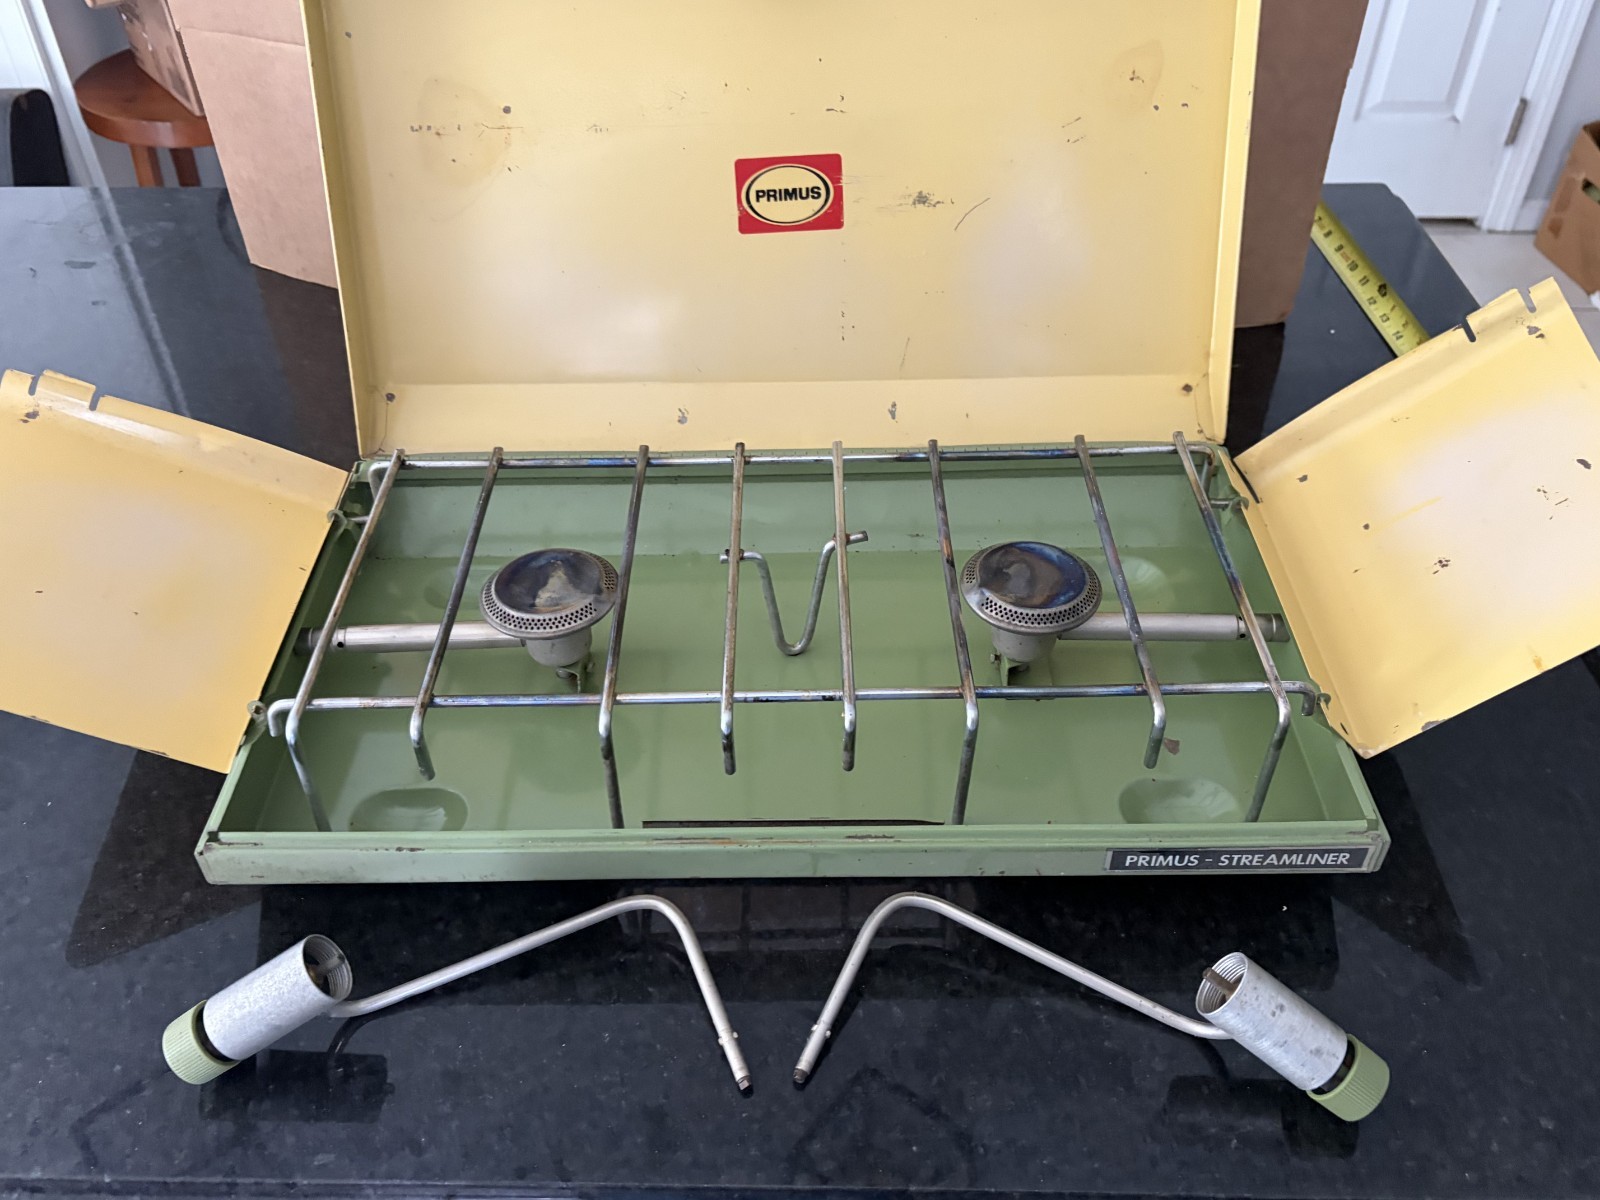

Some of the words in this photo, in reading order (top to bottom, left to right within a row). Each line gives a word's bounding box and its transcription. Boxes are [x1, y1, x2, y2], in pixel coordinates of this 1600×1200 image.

[755, 186, 822, 203] PRIMUS
[1347, 260, 1359, 272] 10
[1358, 275, 1370, 286] 11
[1366, 296, 1377, 306] 12
[1379, 313, 1390, 323] 13
[1392, 330, 1404, 341] 14
[1124, 854, 1200, 867] PRIMUS
[1218, 852, 1351, 866] STREAMLINER
